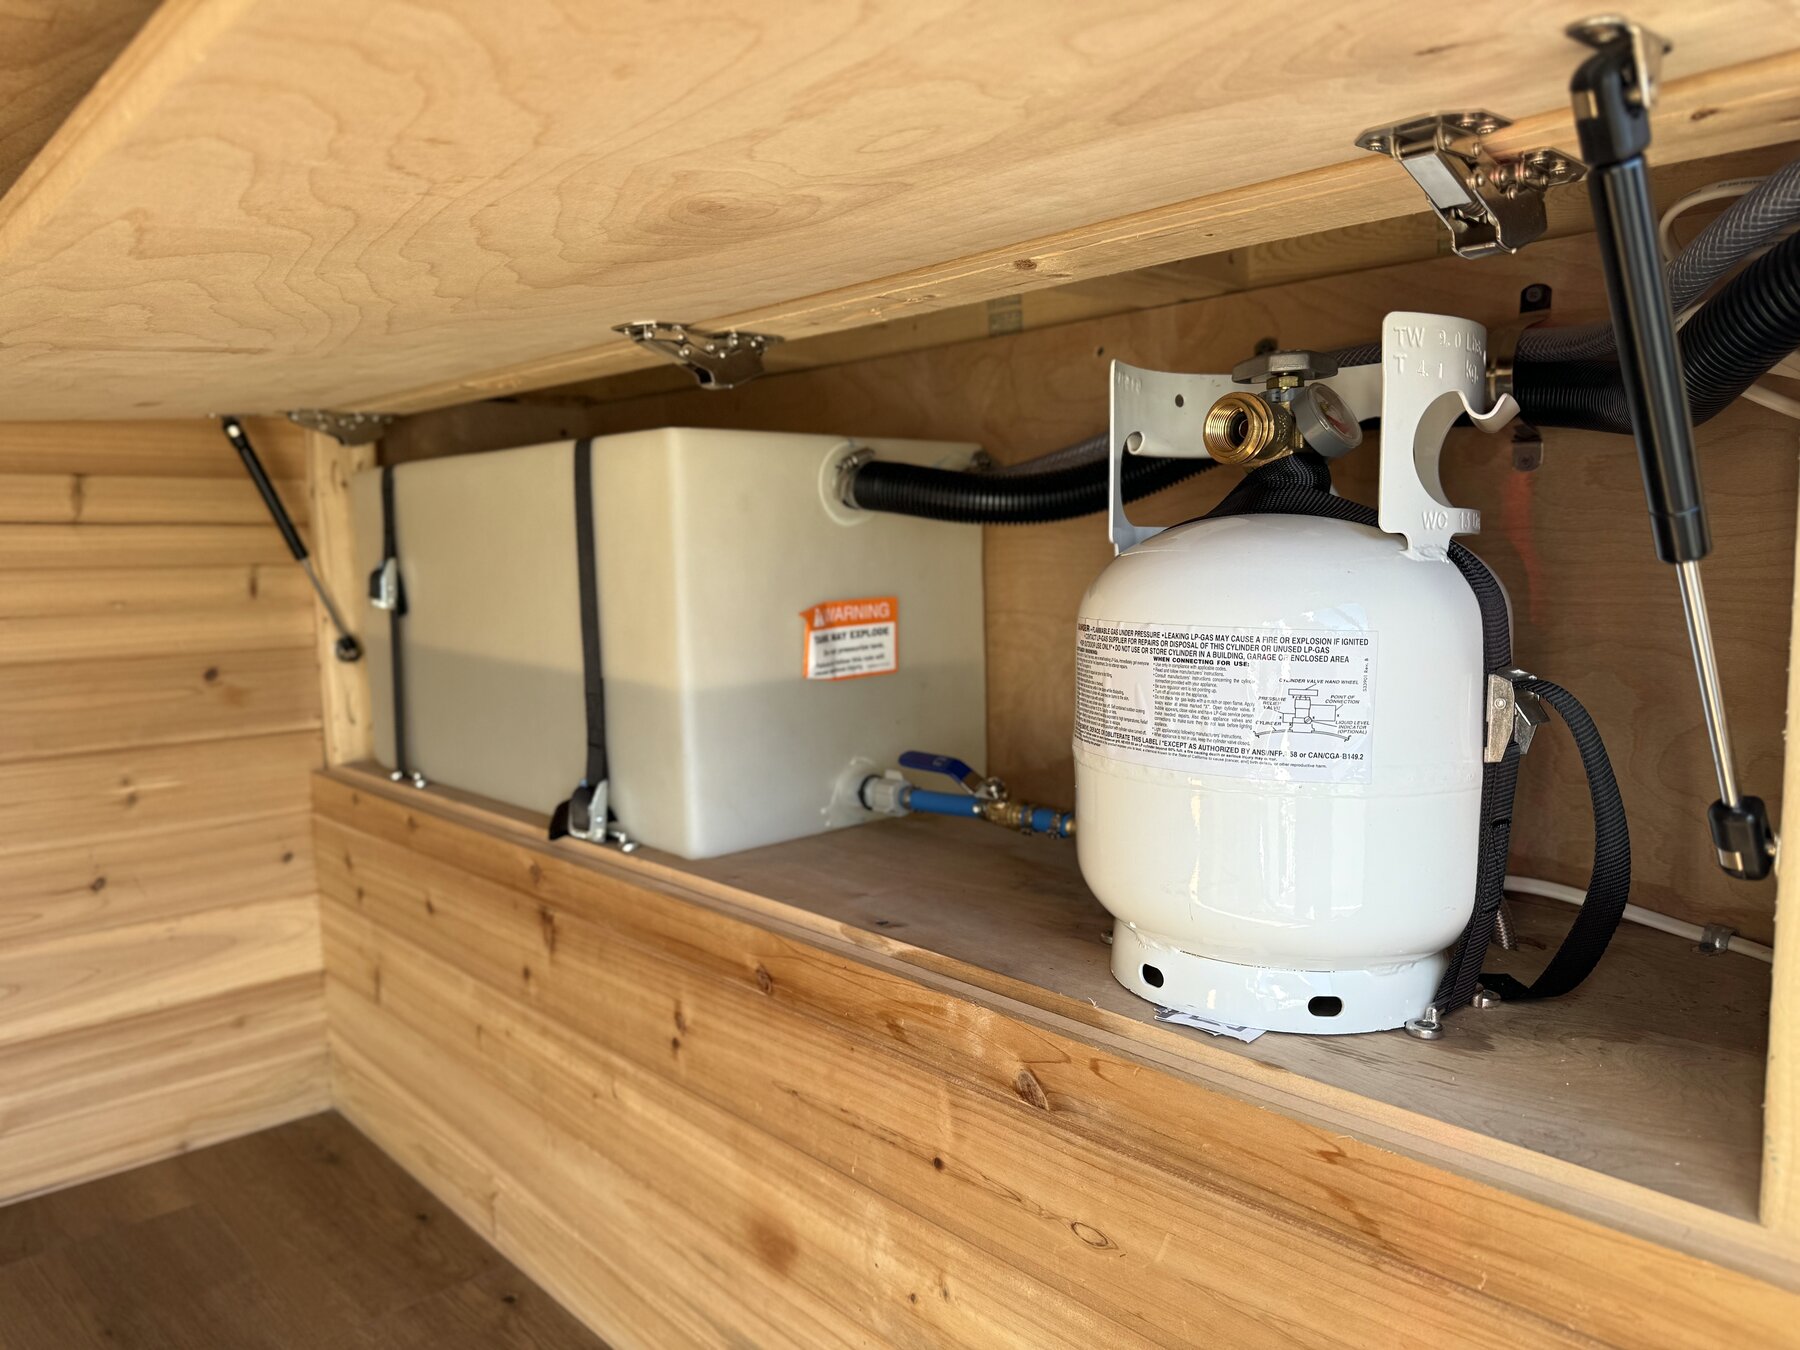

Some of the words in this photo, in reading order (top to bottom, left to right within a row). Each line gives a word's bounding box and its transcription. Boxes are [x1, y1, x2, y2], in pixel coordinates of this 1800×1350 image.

[1393, 327, 1425, 348] TW
[1393, 354, 1407, 374] T
[827, 602, 890, 621] WARNING
[850, 627, 889, 639] EXPLODE
[1169, 649, 1197, 657] CYLINDER
[1213, 652, 1245, 660] BUILDING,
[1170, 641, 1198, 649] DISPOSAL
[1105, 731, 1130, 740] OBLITERATE
[1142, 737, 1158, 745] LABEL
[1198, 744, 1239, 753] AUTHORIZED
